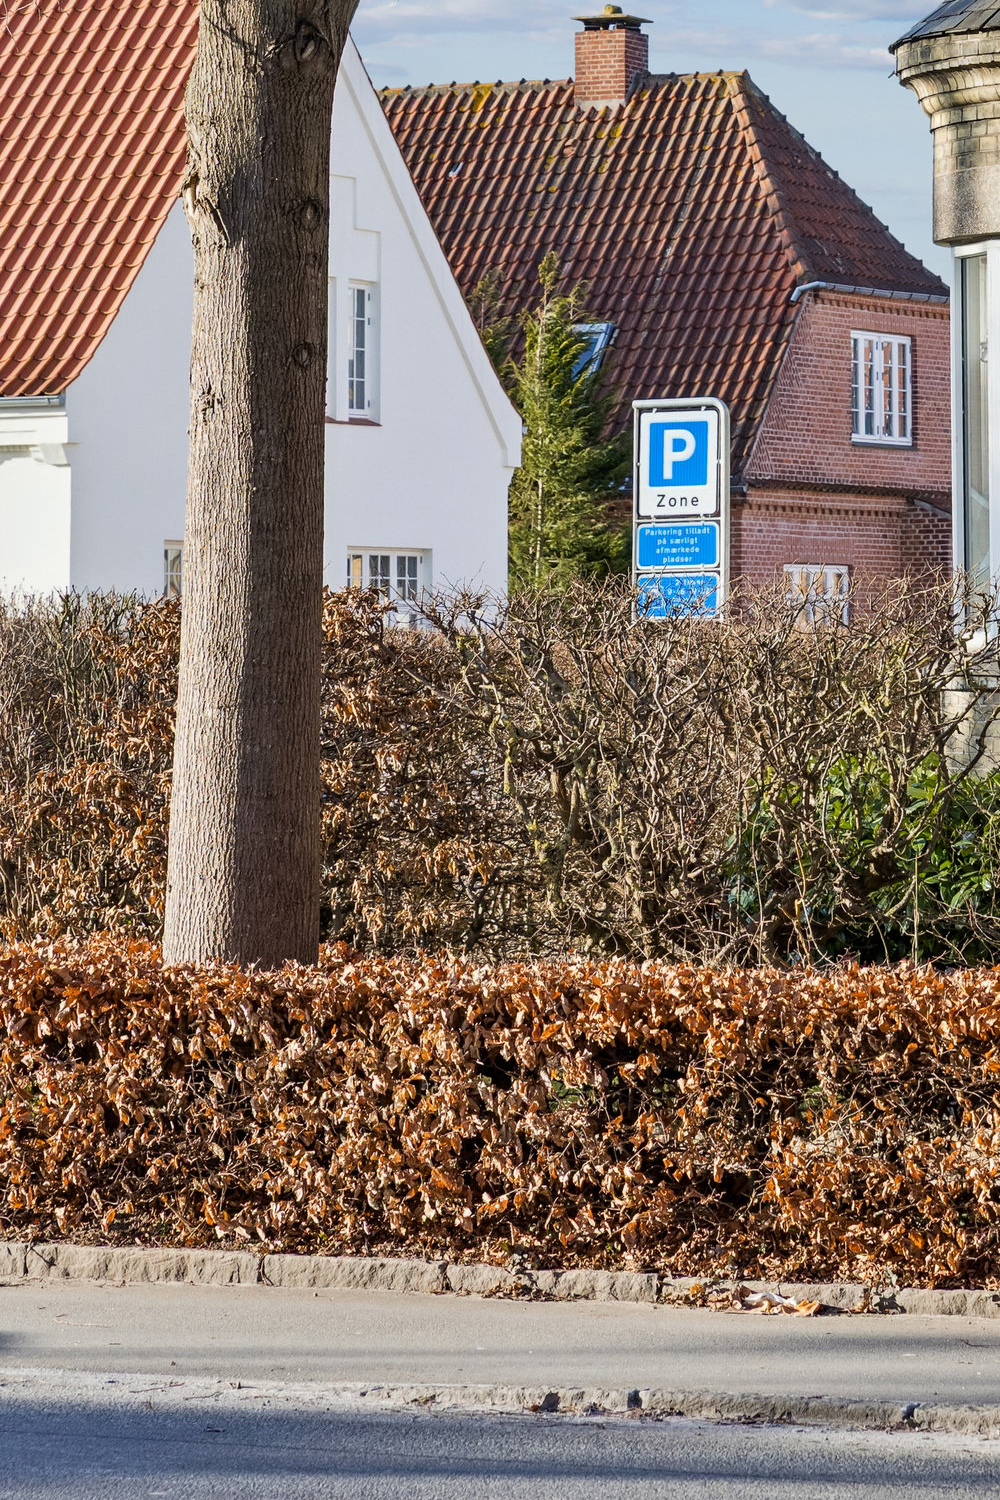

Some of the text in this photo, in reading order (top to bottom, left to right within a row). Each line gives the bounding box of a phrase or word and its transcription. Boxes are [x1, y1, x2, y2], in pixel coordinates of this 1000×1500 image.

[663, 429, 696, 480] P
[657, 494, 699, 507] Zone
[645, 527, 710, 536] Parkering tilladt
[657, 537, 698, 546] på særligt
[656, 546, 700, 554] afmærkede
[662, 556, 693, 564] pladser
